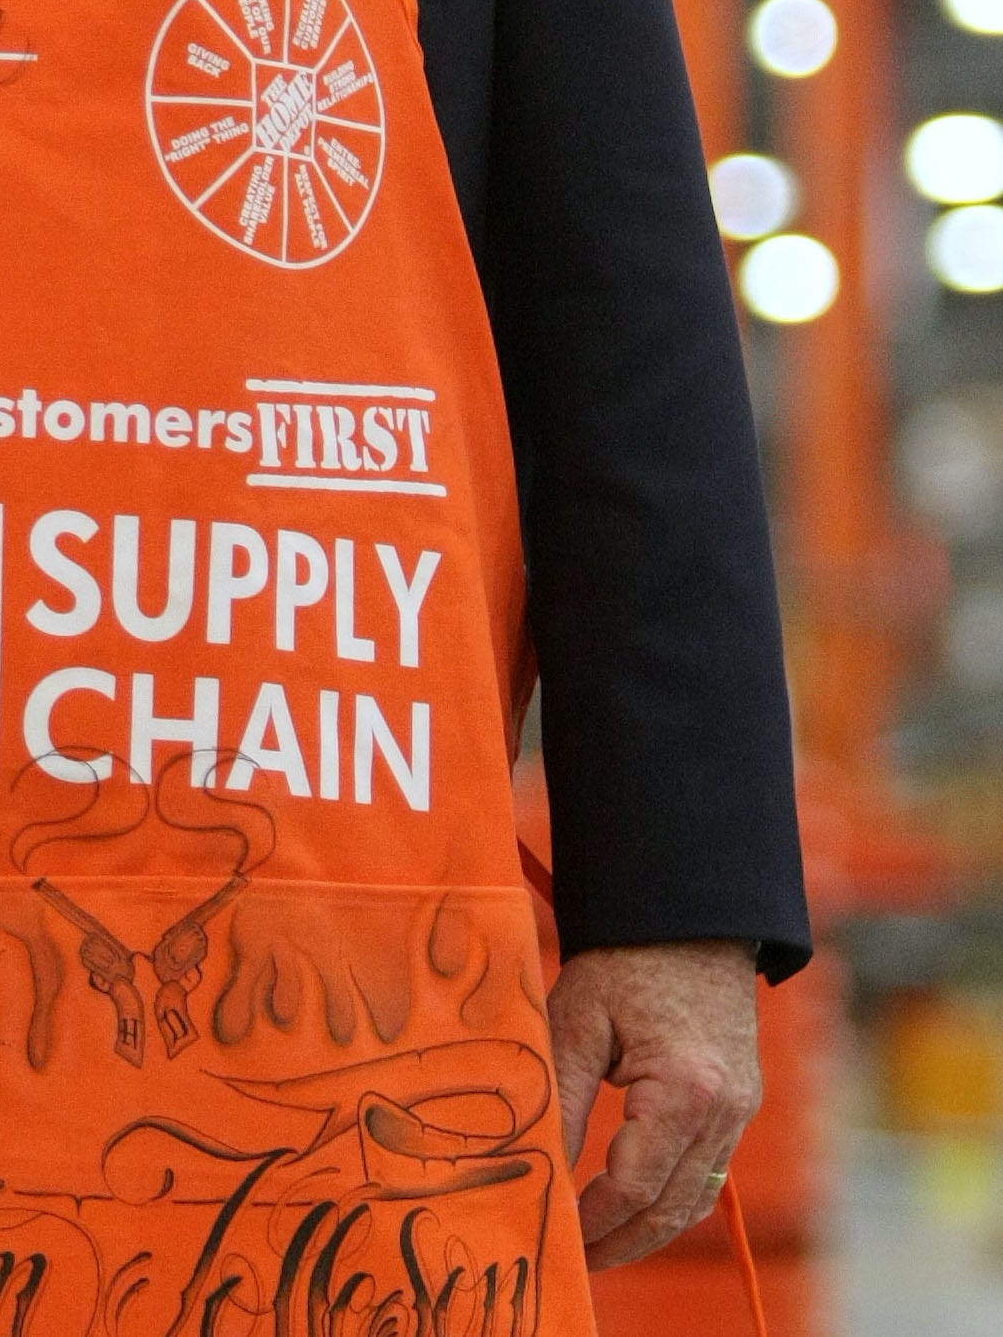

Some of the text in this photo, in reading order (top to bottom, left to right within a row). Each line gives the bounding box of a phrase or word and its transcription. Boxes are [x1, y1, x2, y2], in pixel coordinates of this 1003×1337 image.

[251, 6, 264, 22] OF
[258, 26, 271, 54] OUR
[187, 42, 230, 71] GIVING
[187, 53, 221, 78] BACK
[256, 70, 313, 149] HOME
[261, 73, 288, 109] THE
[171, 116, 235, 150] DOING THE
[212, 122, 249, 144] THING
[280, 103, 314, 152] DEPOT
[239, 165, 263, 226] CREATING
[243, 155, 274, 245] SHAREHOLDER
[259, 184, 276, 223] VALUE
[294, 173, 304, 198] ALL
[315, 223, 328, 250] FOR
[256, 401, 430, 473] FIRST
[25, 509, 443, 668] SUPPLY
[23, 665, 431, 812] CHAIN
